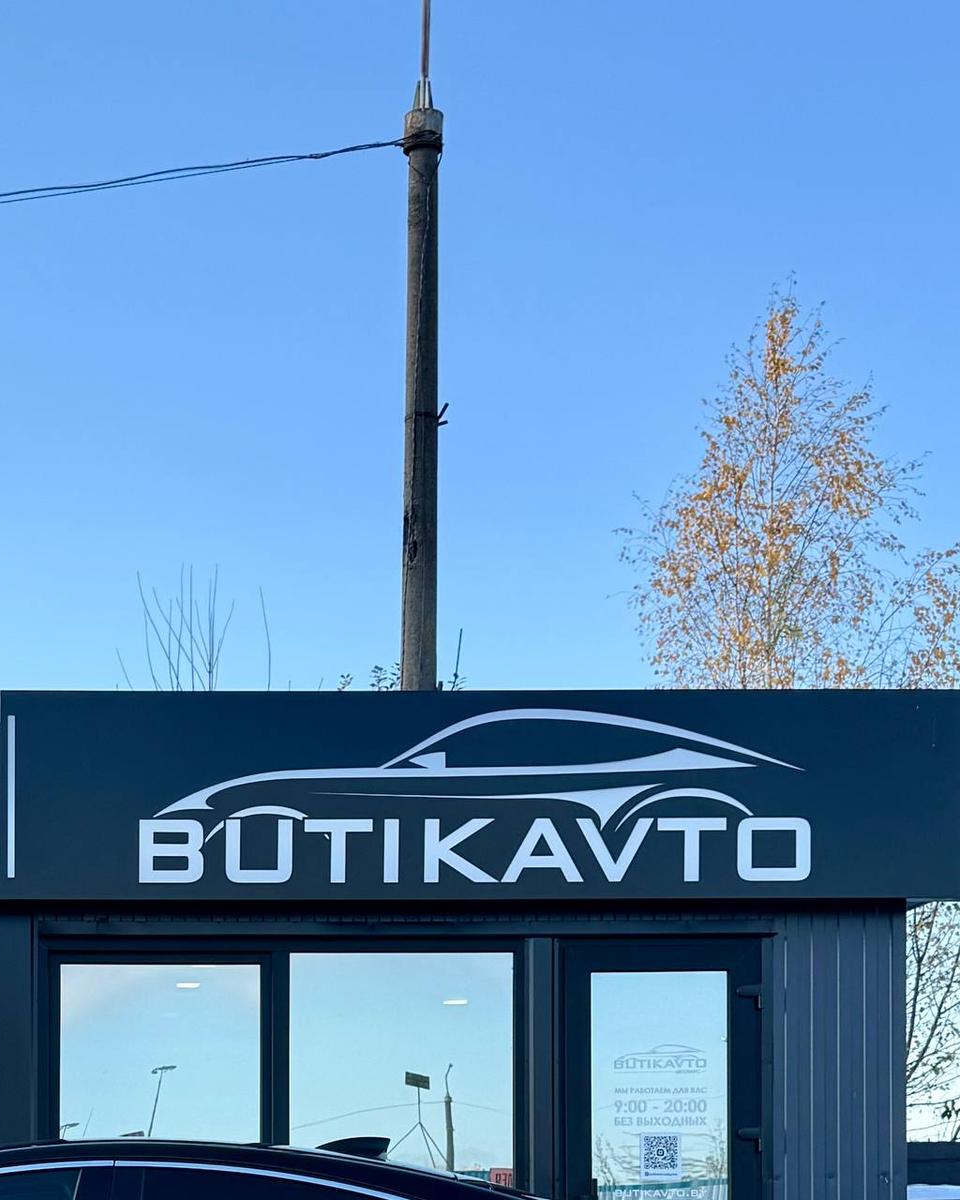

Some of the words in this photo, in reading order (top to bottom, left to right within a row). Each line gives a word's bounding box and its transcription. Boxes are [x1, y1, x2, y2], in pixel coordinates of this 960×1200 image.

[138, 817, 812, 884] BUTIKAVTO
[613, 1058, 708, 1070] BUTIKAVTO
[614, 1087, 629, 1095] МЫ
[629, 1087, 672, 1095] РАБОТАЕМ
[672, 1087, 689, 1095] ДЛЯ
[614, 1099, 647, 1113] 9:00
[663, 1099, 708, 1113] 20:00
[613, 1116, 634, 1126] БЕЗ
[636, 1116, 708, 1127] ВЫХОДНЫХ
[614, 1189, 708, 1198] BUTIKAVTO.BY
